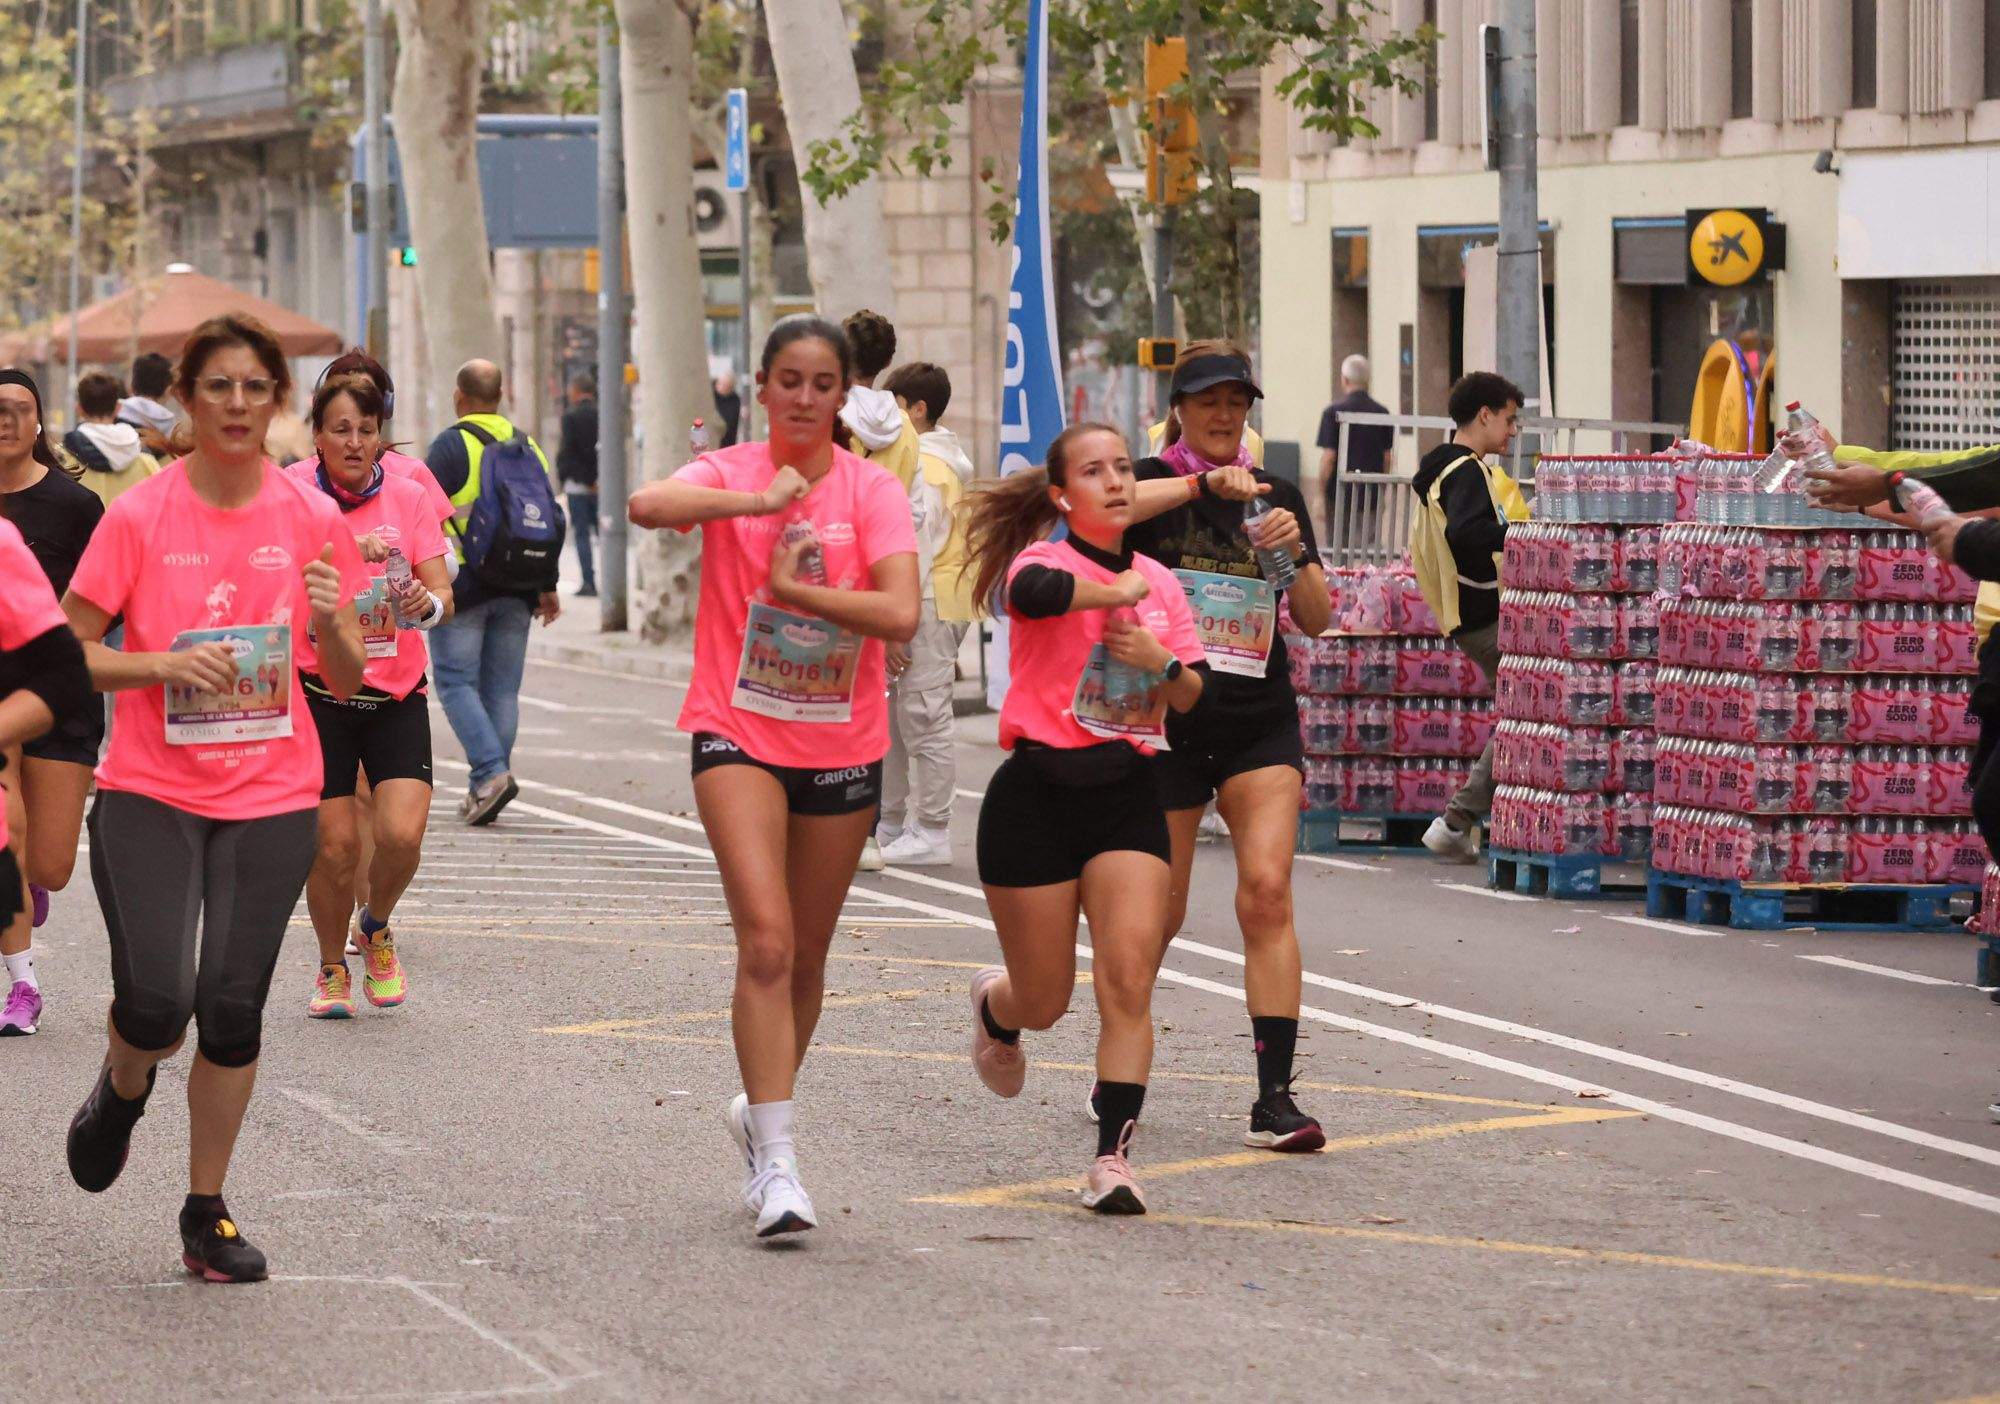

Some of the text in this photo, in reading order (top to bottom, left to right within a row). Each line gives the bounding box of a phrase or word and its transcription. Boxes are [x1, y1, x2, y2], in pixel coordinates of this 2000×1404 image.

[1892, 564, 1924, 573] ZERO
[1892, 572, 1924, 581] SODIO
[1202, 615, 1241, 635] 016
[1894, 636, 1924, 645] ZERO
[1893, 645, 1925, 654] SODIO
[1886, 705, 1917, 713] ZERO
[1885, 713, 1918, 722] SODIO
[814, 764, 869, 786] GRIFOLS
[1884, 777, 1916, 786] ZERO
[1884, 785, 1916, 794] SODIO
[1883, 849, 1914, 857] ZERO
[1883, 857, 1914, 866] SODIO
